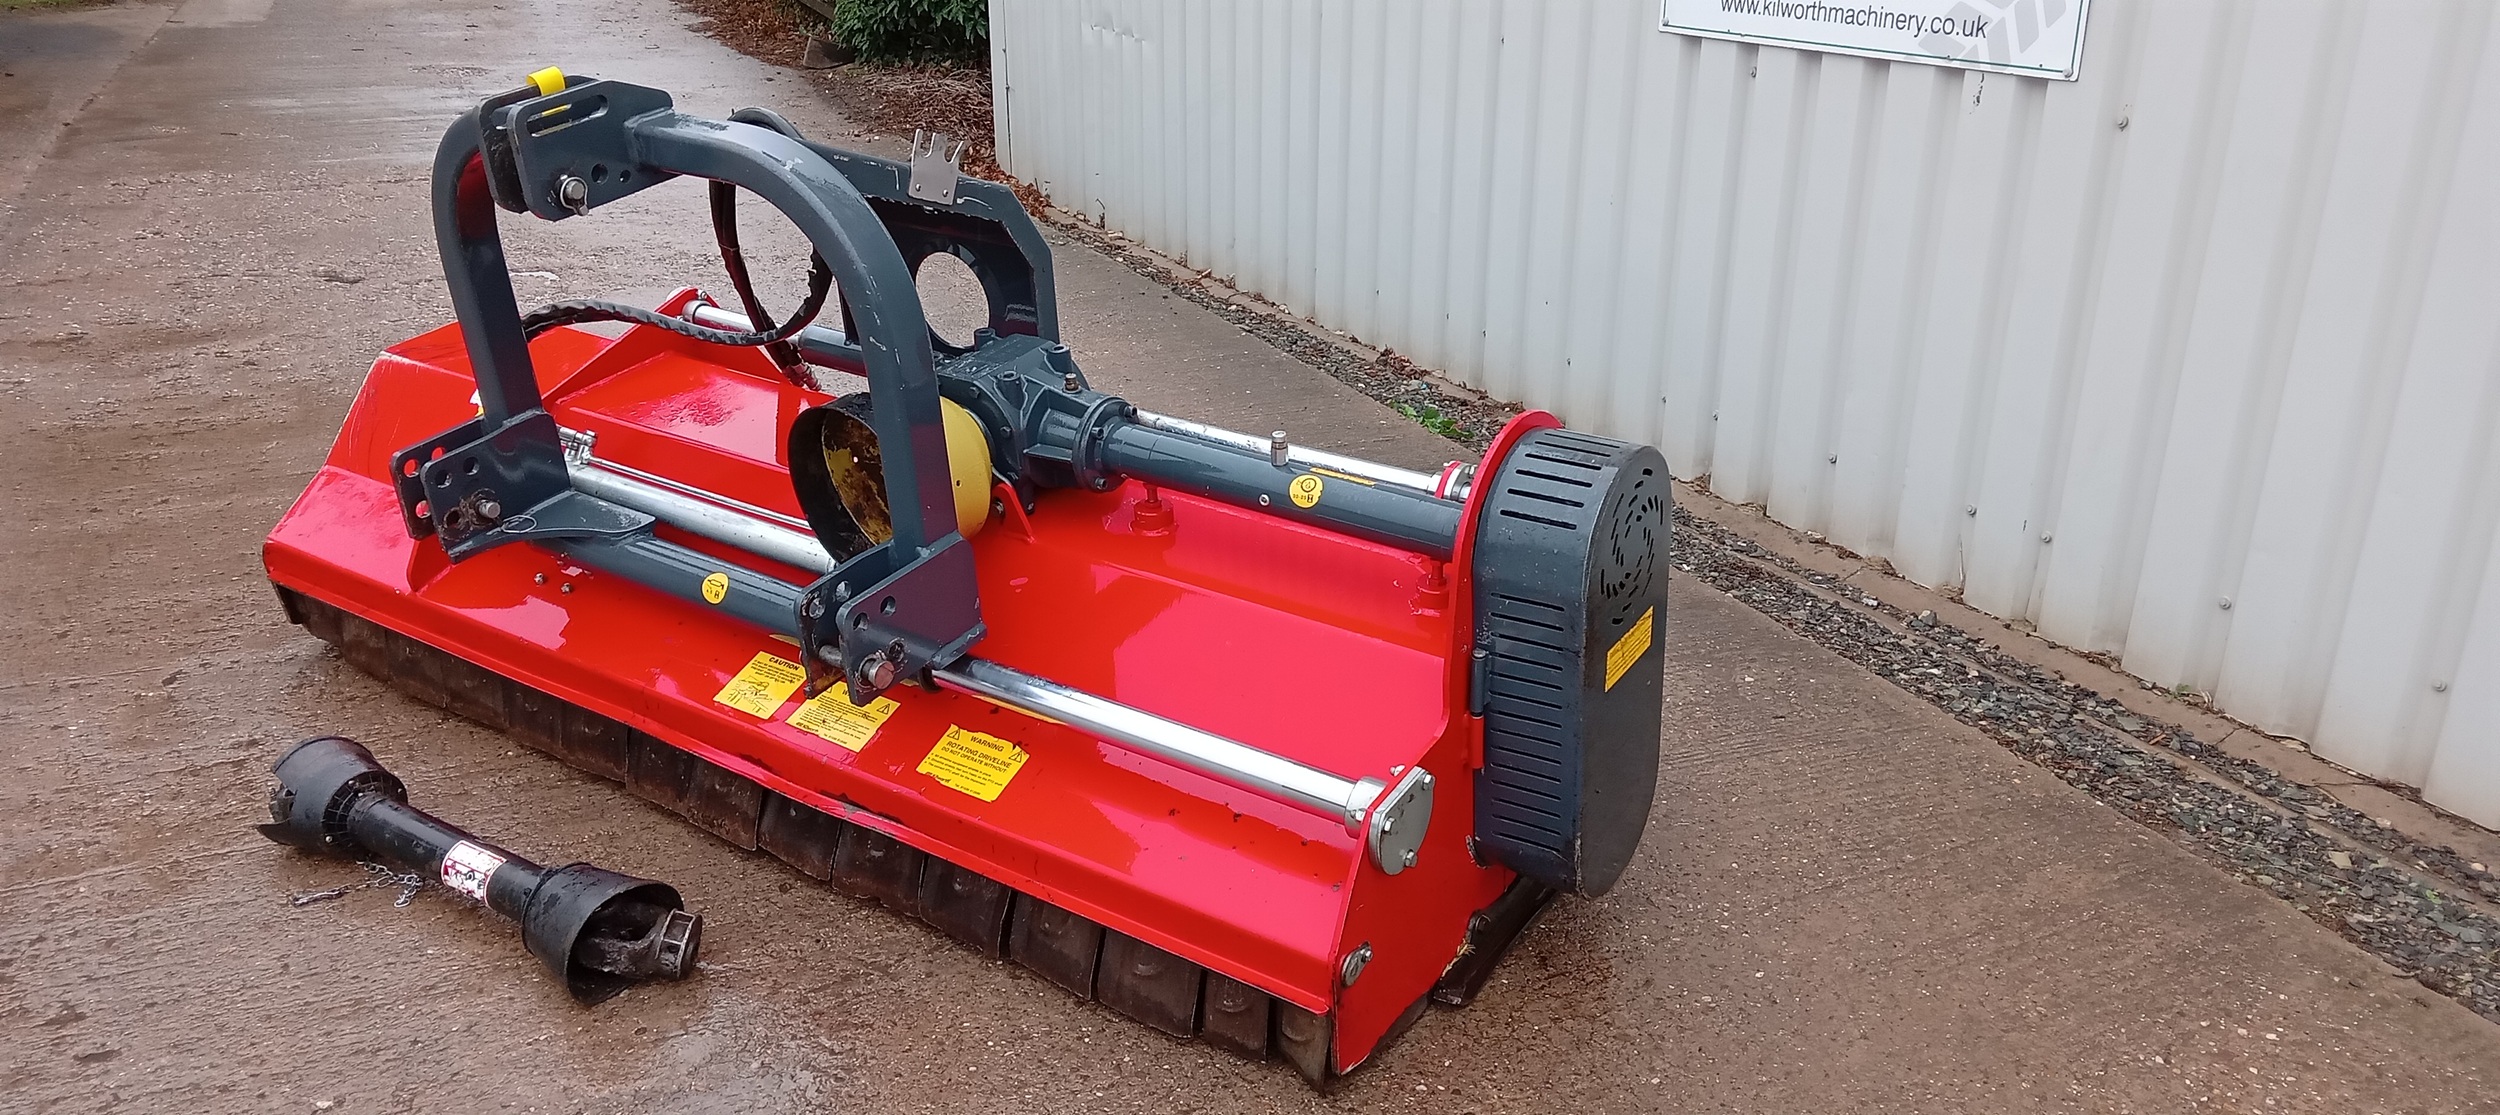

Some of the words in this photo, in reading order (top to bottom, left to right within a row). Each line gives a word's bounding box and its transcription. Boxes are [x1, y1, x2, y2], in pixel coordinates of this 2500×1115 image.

[1720, 0, 1988, 39] www.kilworthmachinery.co.uk
[768, 656, 800, 671] CAUTION
[946, 740, 979, 756] ROTATING
[978, 752, 1012, 769] DRIVELINE
[970, 735, 1005, 752] WARNING
[949, 748, 961, 757] NOT
[960, 753, 984, 765] OPERATE
[983, 761, 1007, 774] WITHOUT
